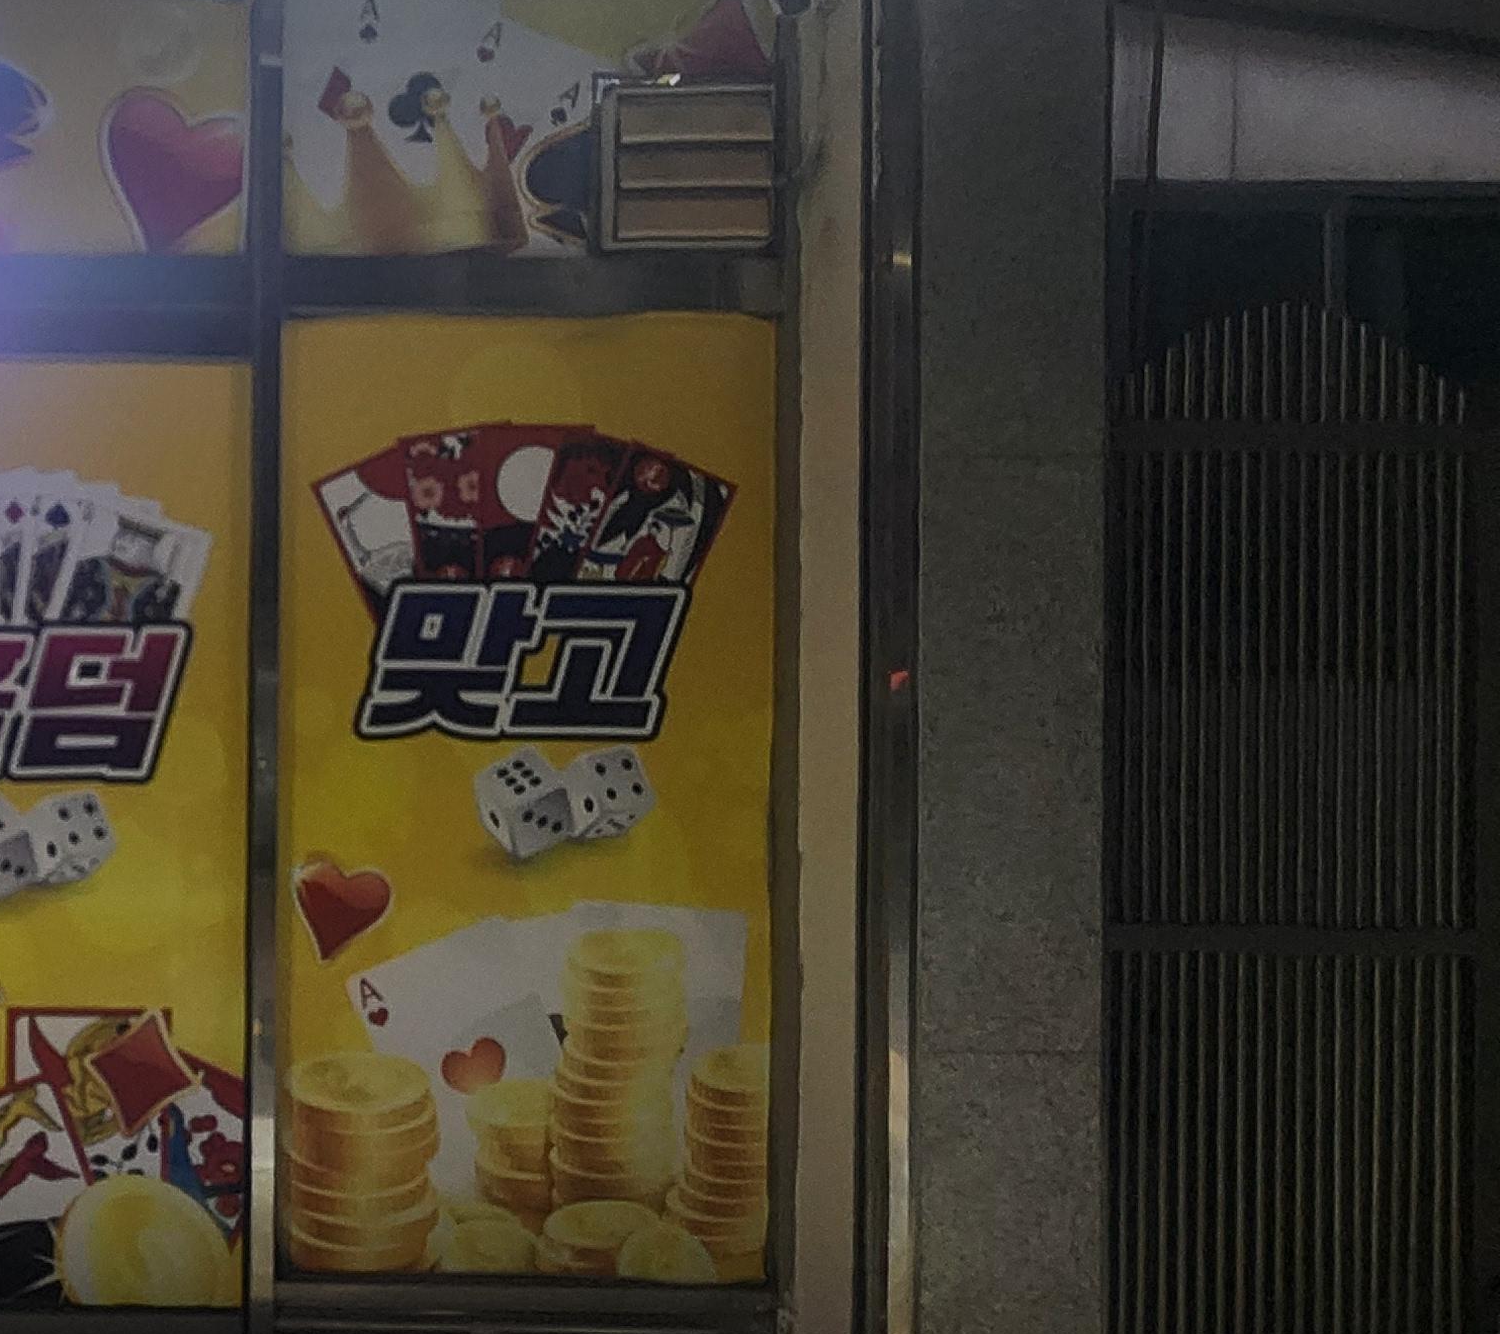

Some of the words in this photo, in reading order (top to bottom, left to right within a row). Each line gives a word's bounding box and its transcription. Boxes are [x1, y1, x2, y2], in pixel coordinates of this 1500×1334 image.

[481, 21, 503, 48] A
[558, 81, 581, 109] A
[355, 581, 690, 739] 맞고
[359, 977, 383, 1009] A
